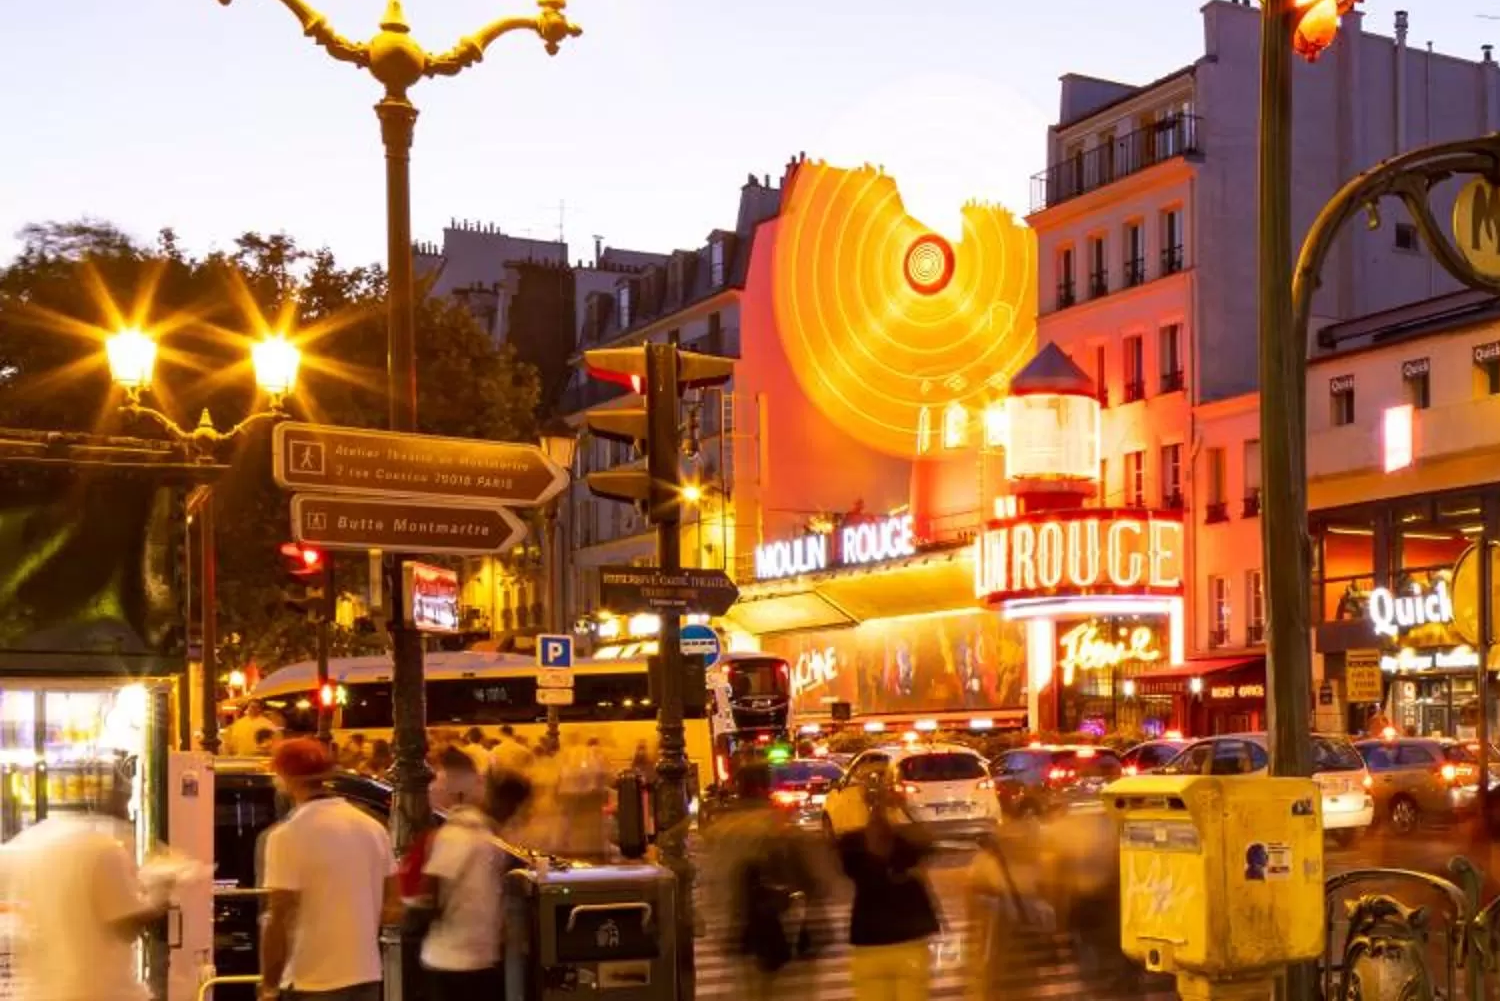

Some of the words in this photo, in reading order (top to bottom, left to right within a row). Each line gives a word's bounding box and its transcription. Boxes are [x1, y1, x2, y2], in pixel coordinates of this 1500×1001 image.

[1475, 346, 1500, 362] Quick
[337, 515, 384, 531] Butte
[393, 518, 490, 536] Montmartre
[756, 534, 826, 579] MOULIN
[843, 515, 917, 564] ROUGE
[1012, 517, 1182, 592] ROUGE
[548, 642, 563, 663] P
